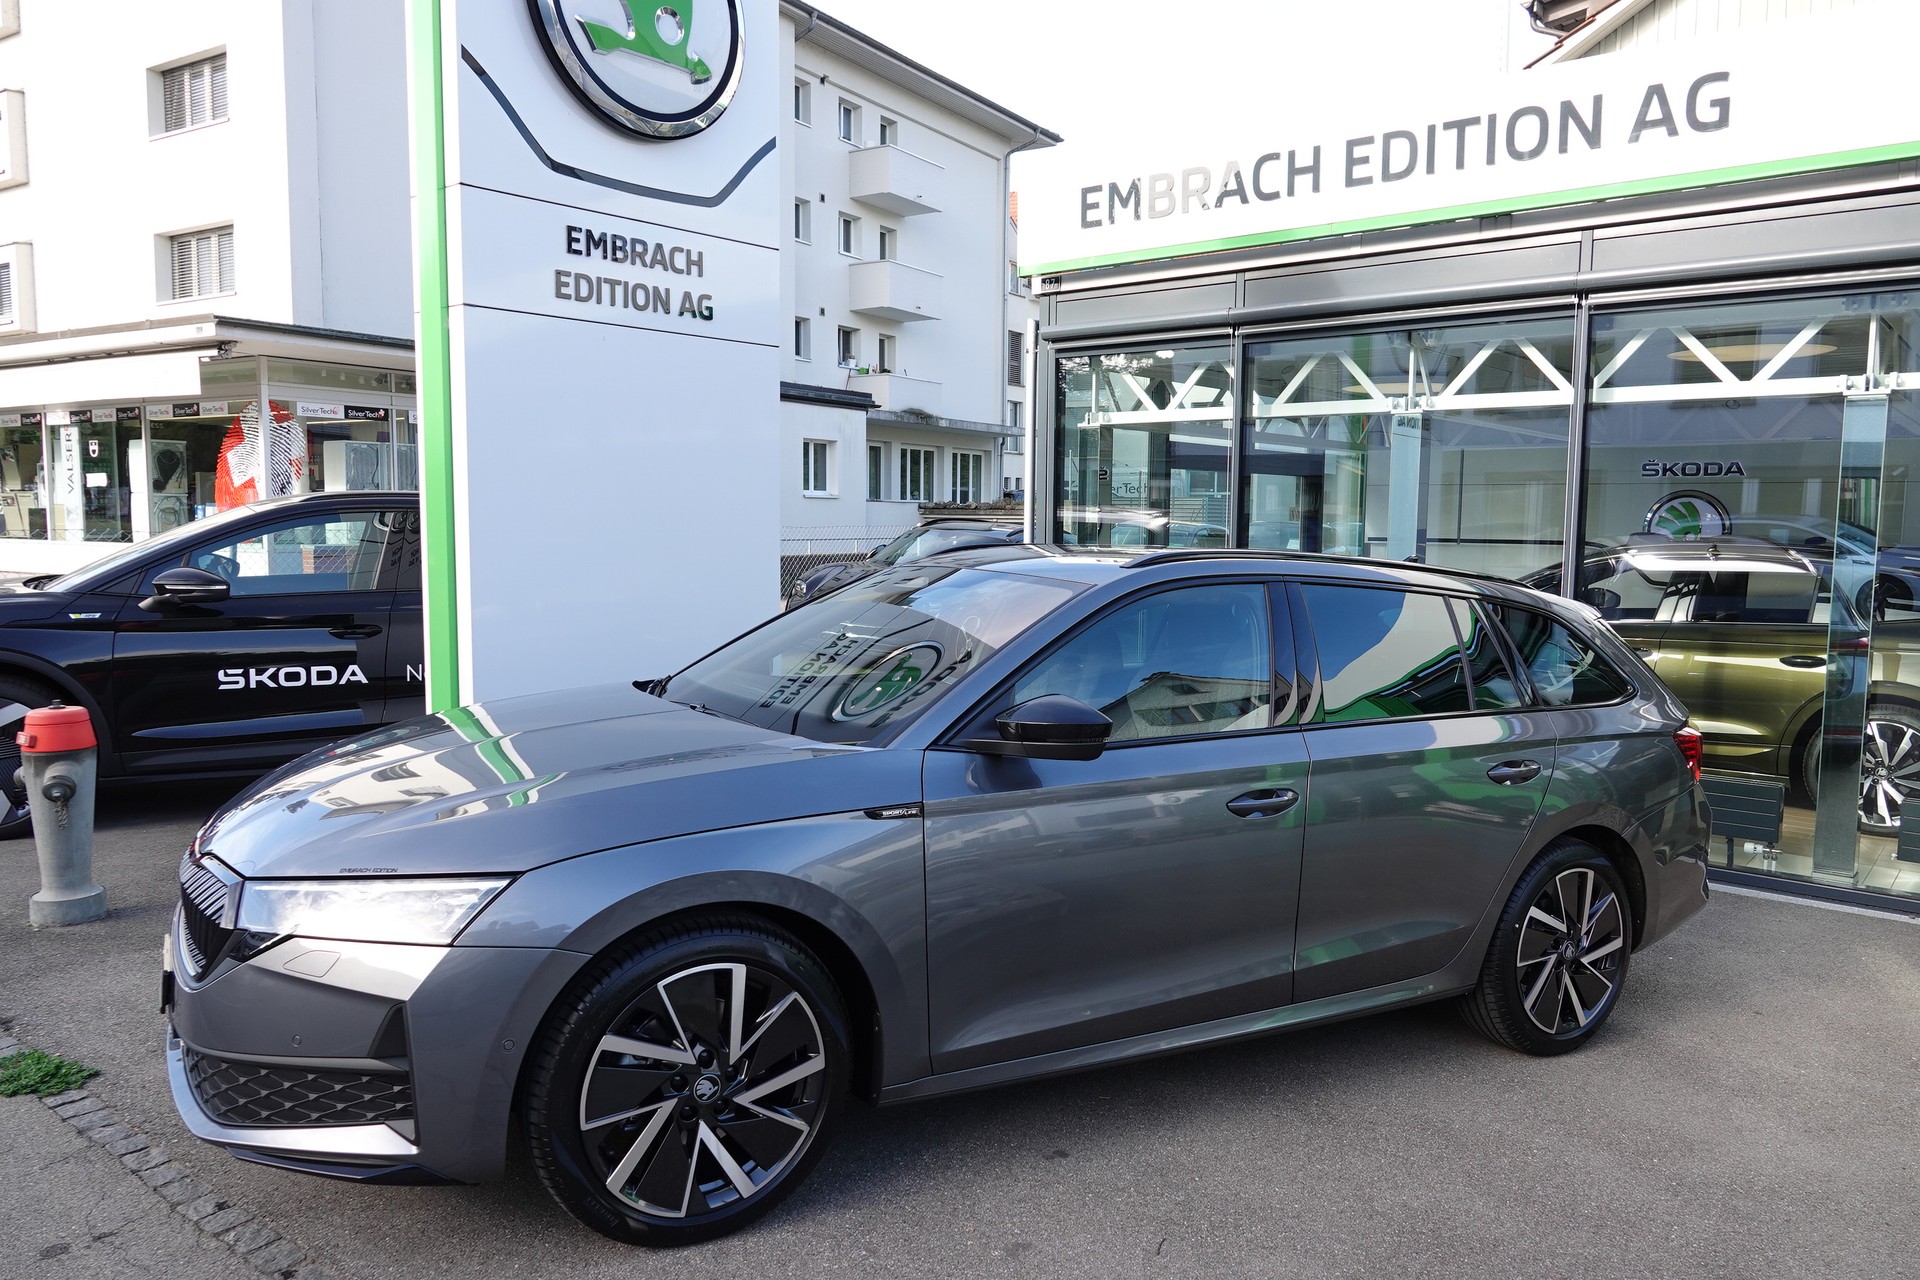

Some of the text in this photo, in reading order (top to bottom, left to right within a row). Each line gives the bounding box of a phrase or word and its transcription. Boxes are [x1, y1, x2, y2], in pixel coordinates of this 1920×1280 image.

[1080, 71, 1731, 229] EMBRACH EDITION AG
[566, 225, 704, 277] EMBRACH
[555, 269, 714, 321] EDITION AG
[65, 433, 74, 494] VALSER
[1641, 459, 1746, 478] ŠKODA
[406, 664, 425, 682] N
